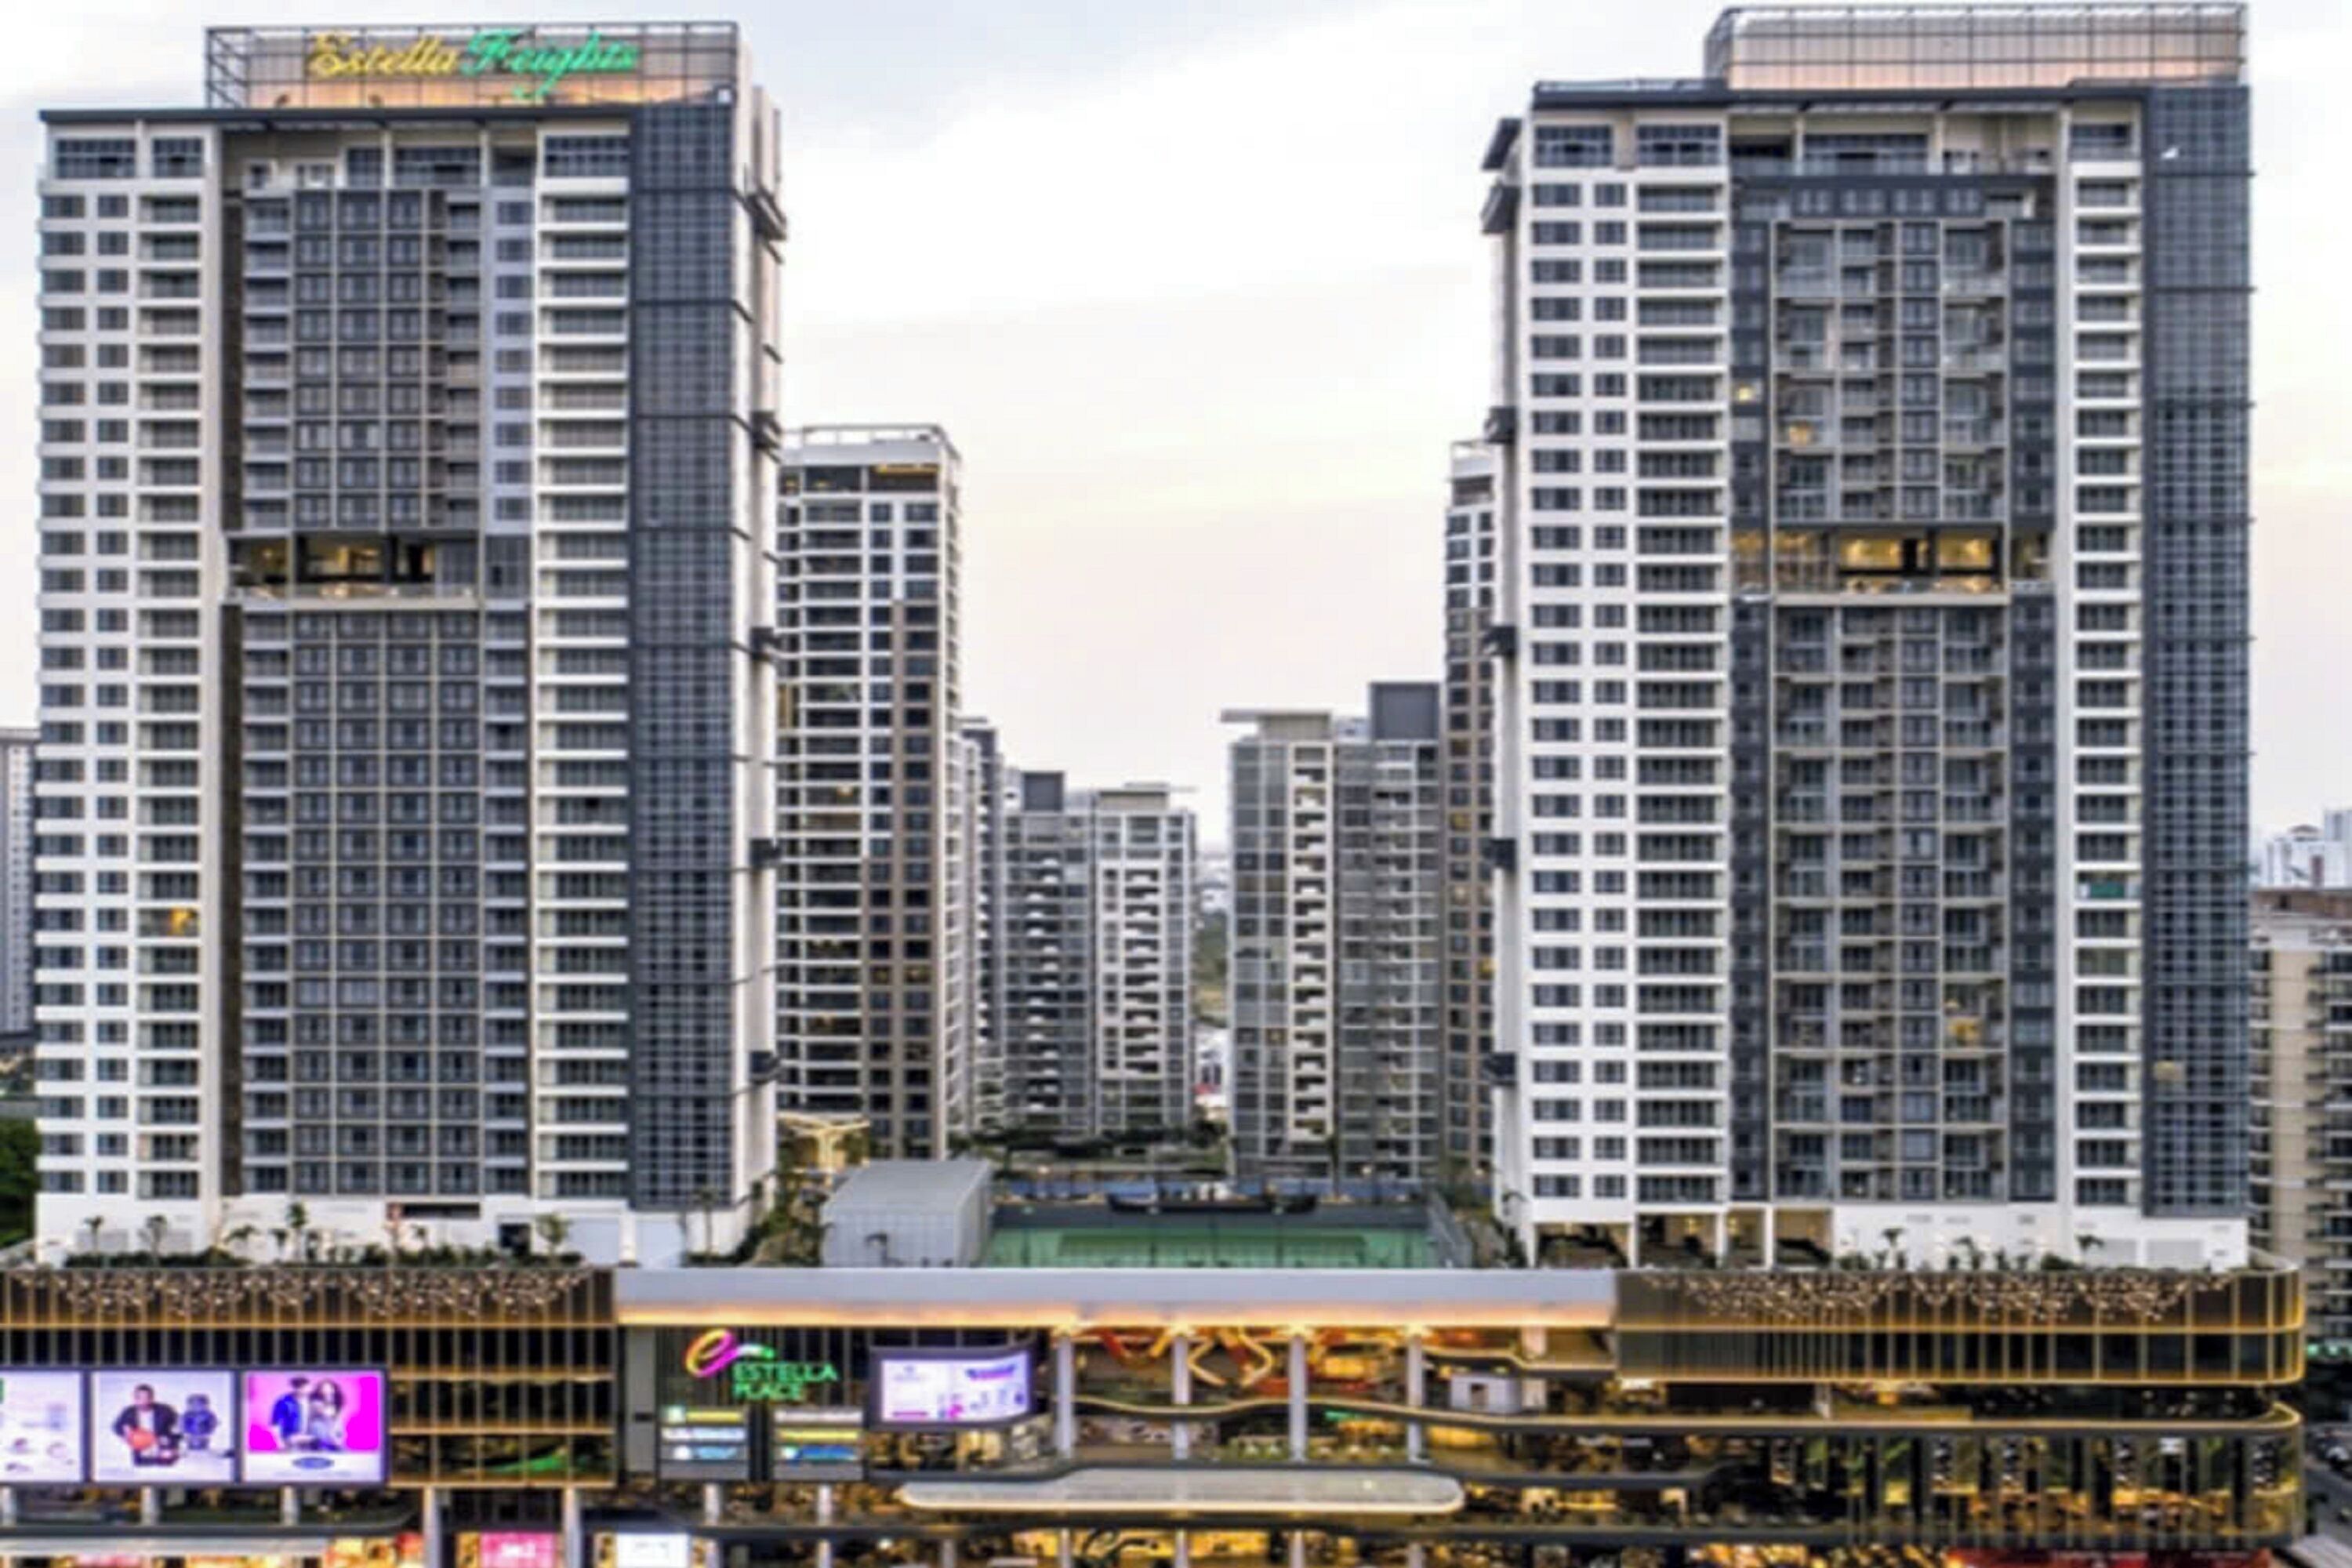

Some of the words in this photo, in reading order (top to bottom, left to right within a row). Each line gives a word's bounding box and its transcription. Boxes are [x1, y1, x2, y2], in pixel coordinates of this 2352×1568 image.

[310, 32, 459, 75] Estella
[460, 30, 640, 100] Heights
[731, 1363, 838, 1382] ESTELLA
[731, 1382, 803, 1401] PLACE
